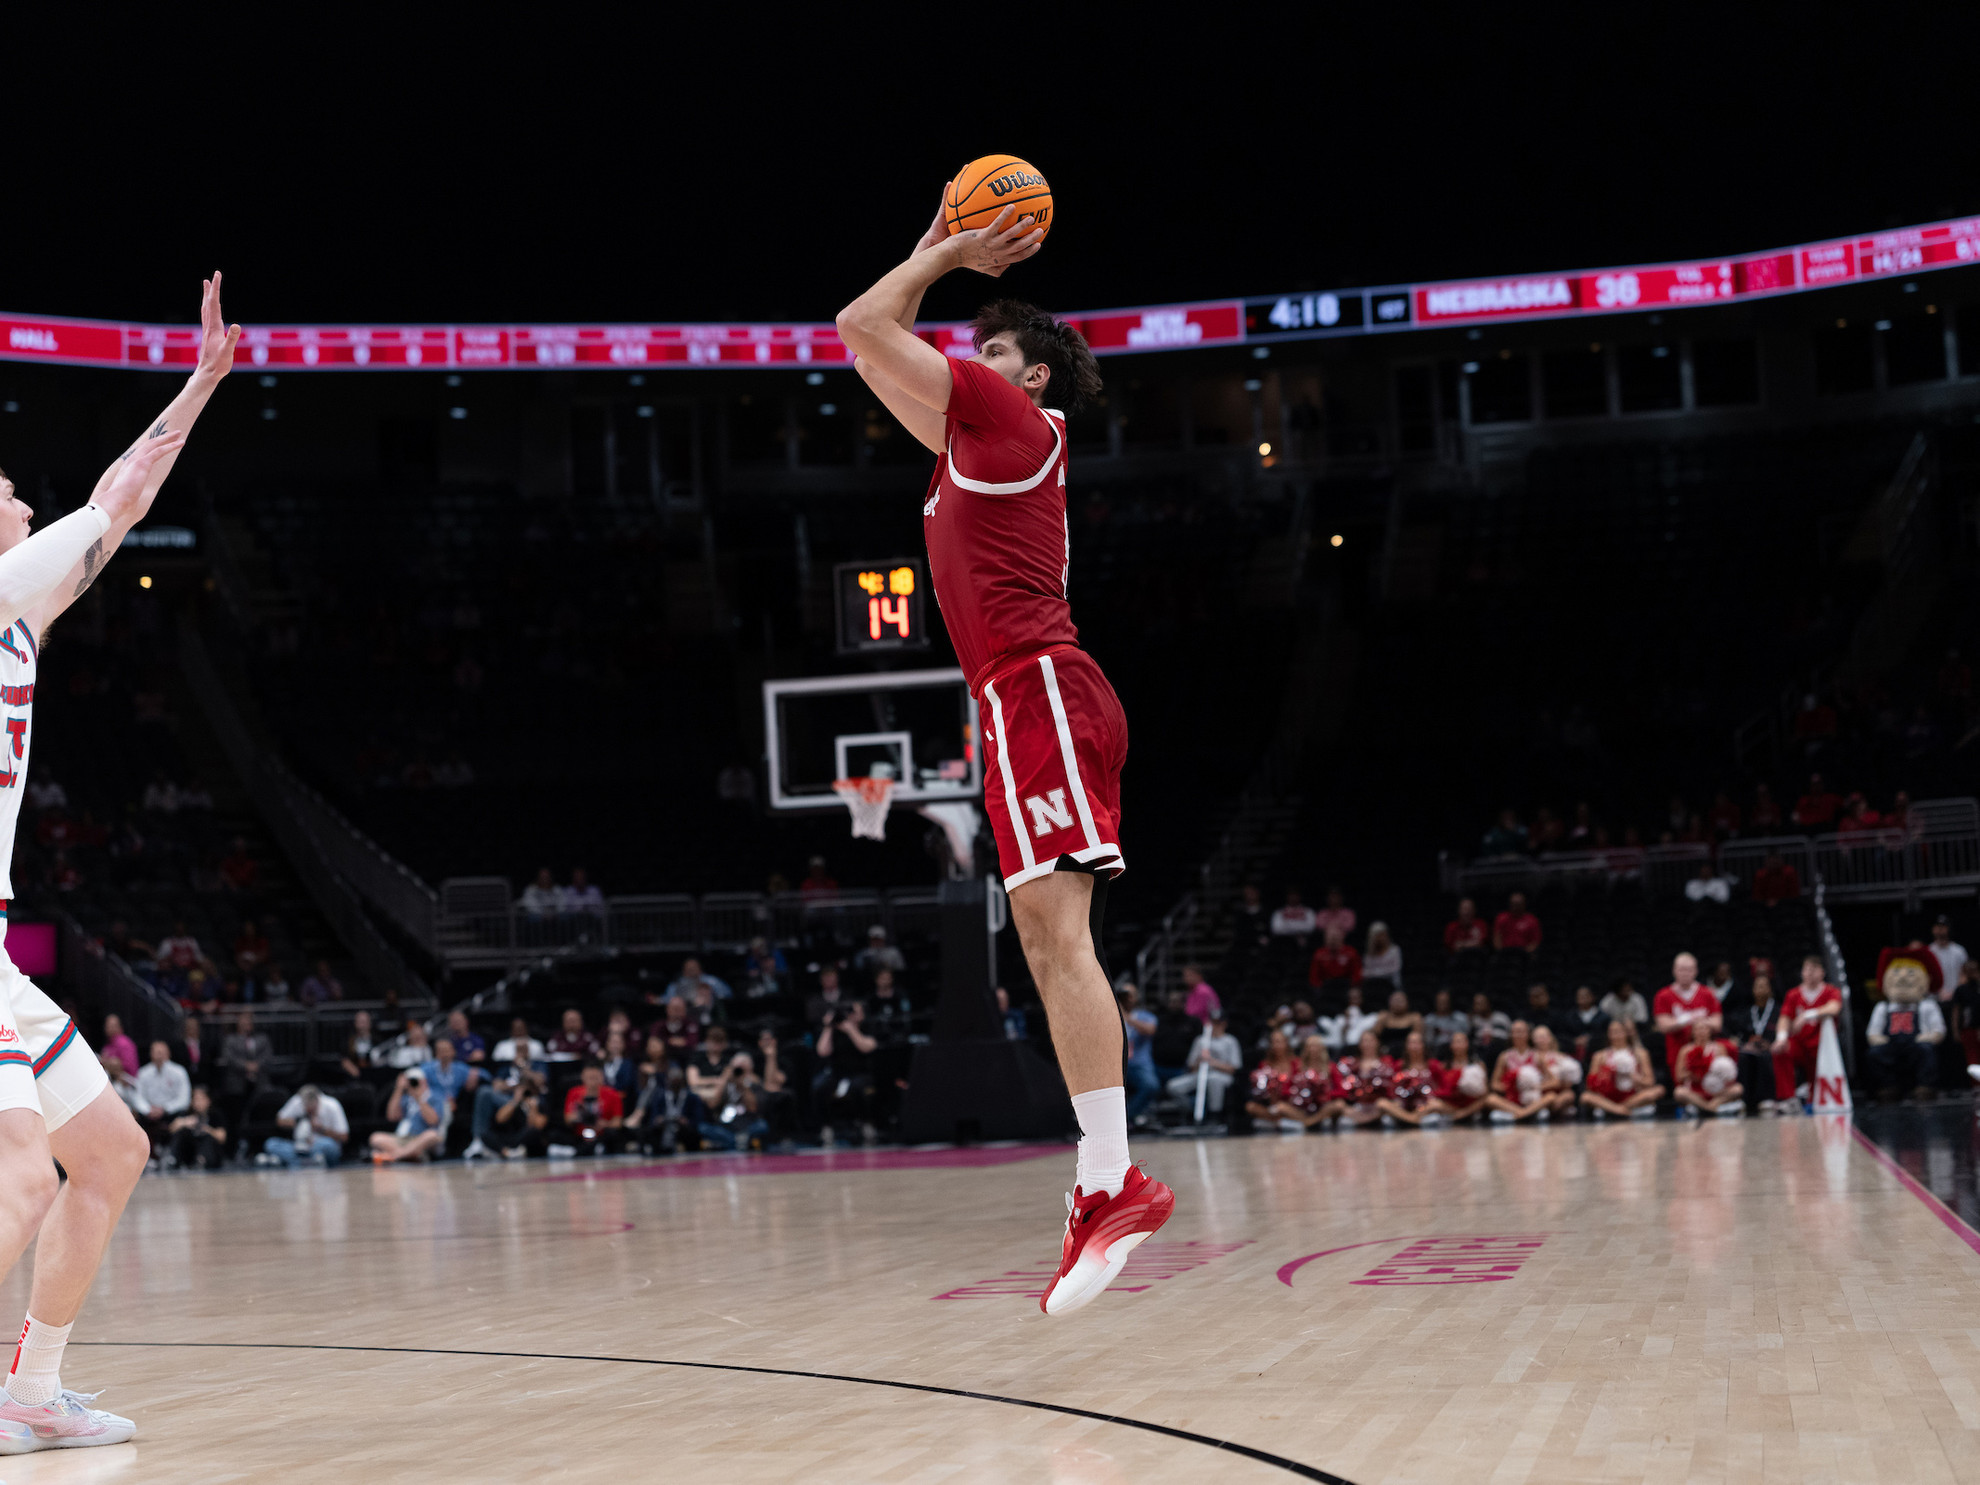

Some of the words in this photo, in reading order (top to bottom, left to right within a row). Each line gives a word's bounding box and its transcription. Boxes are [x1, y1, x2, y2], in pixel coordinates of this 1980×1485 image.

[1426, 278, 1573, 316] NEBRASKA
[868, 594, 910, 641] 14
[1024, 786, 1075, 838] N
[1817, 1076, 1845, 1105] N
